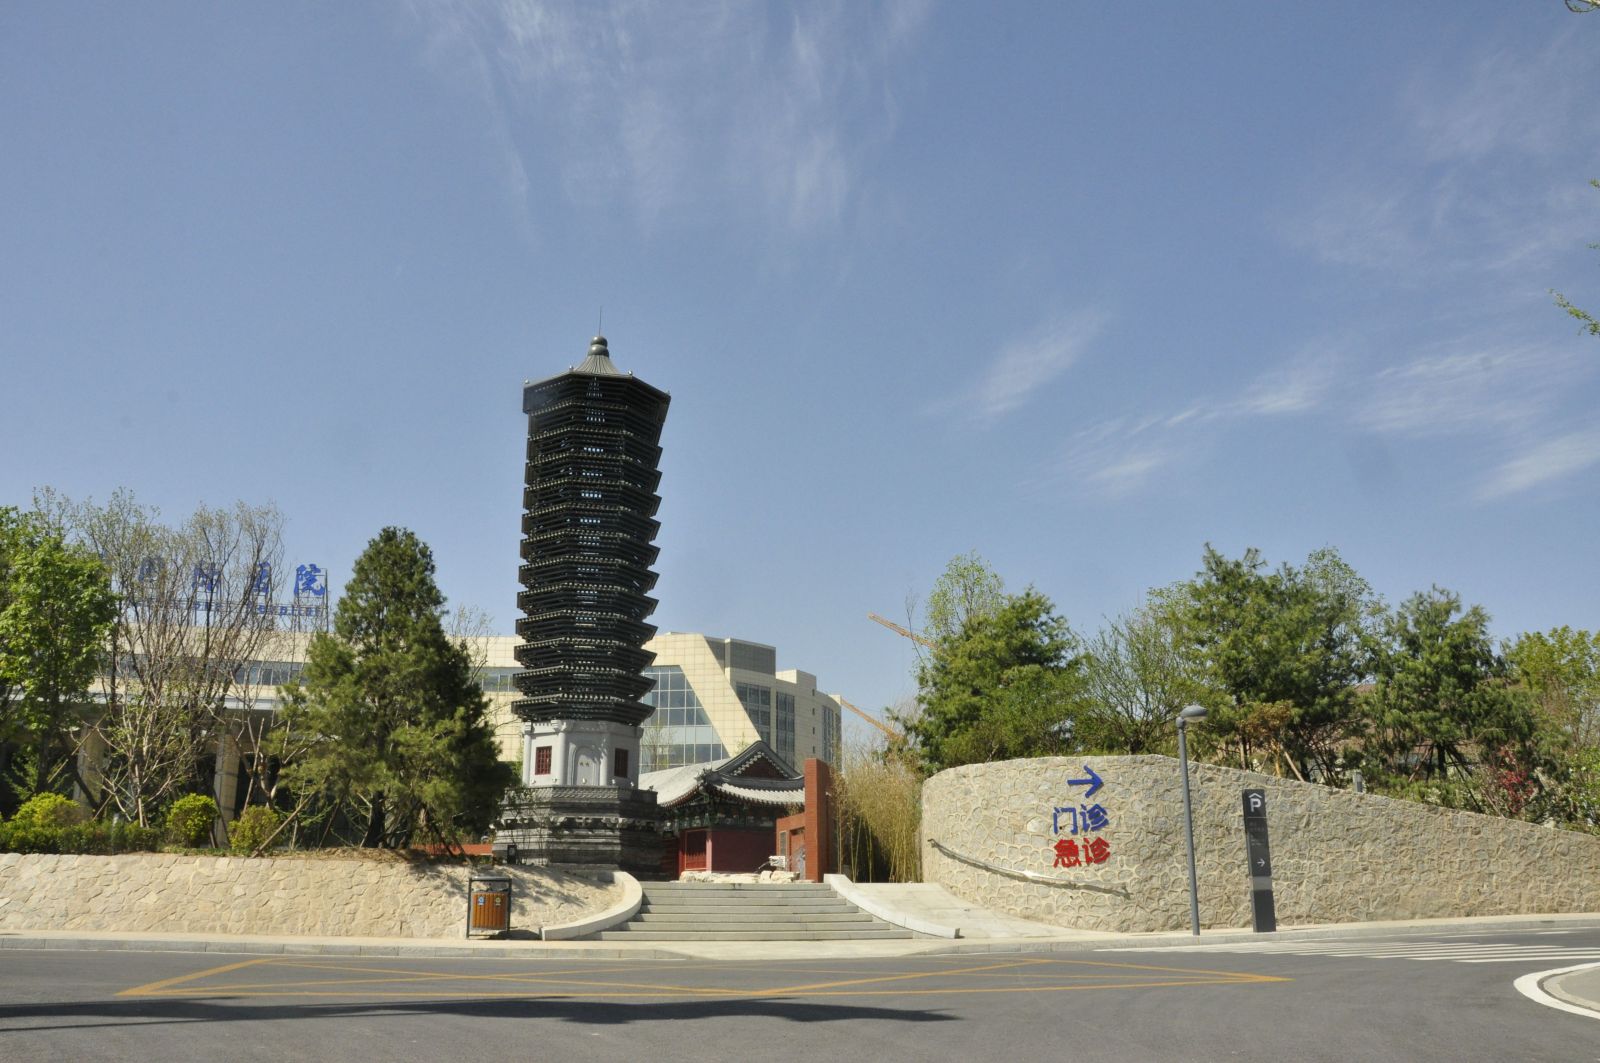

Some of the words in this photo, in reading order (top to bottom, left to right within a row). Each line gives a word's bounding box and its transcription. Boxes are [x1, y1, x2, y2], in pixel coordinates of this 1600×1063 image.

[1053, 804, 1109, 835] 门诊
[1250, 798, 1262, 812] P
[1053, 836, 1110, 868] 急诊
